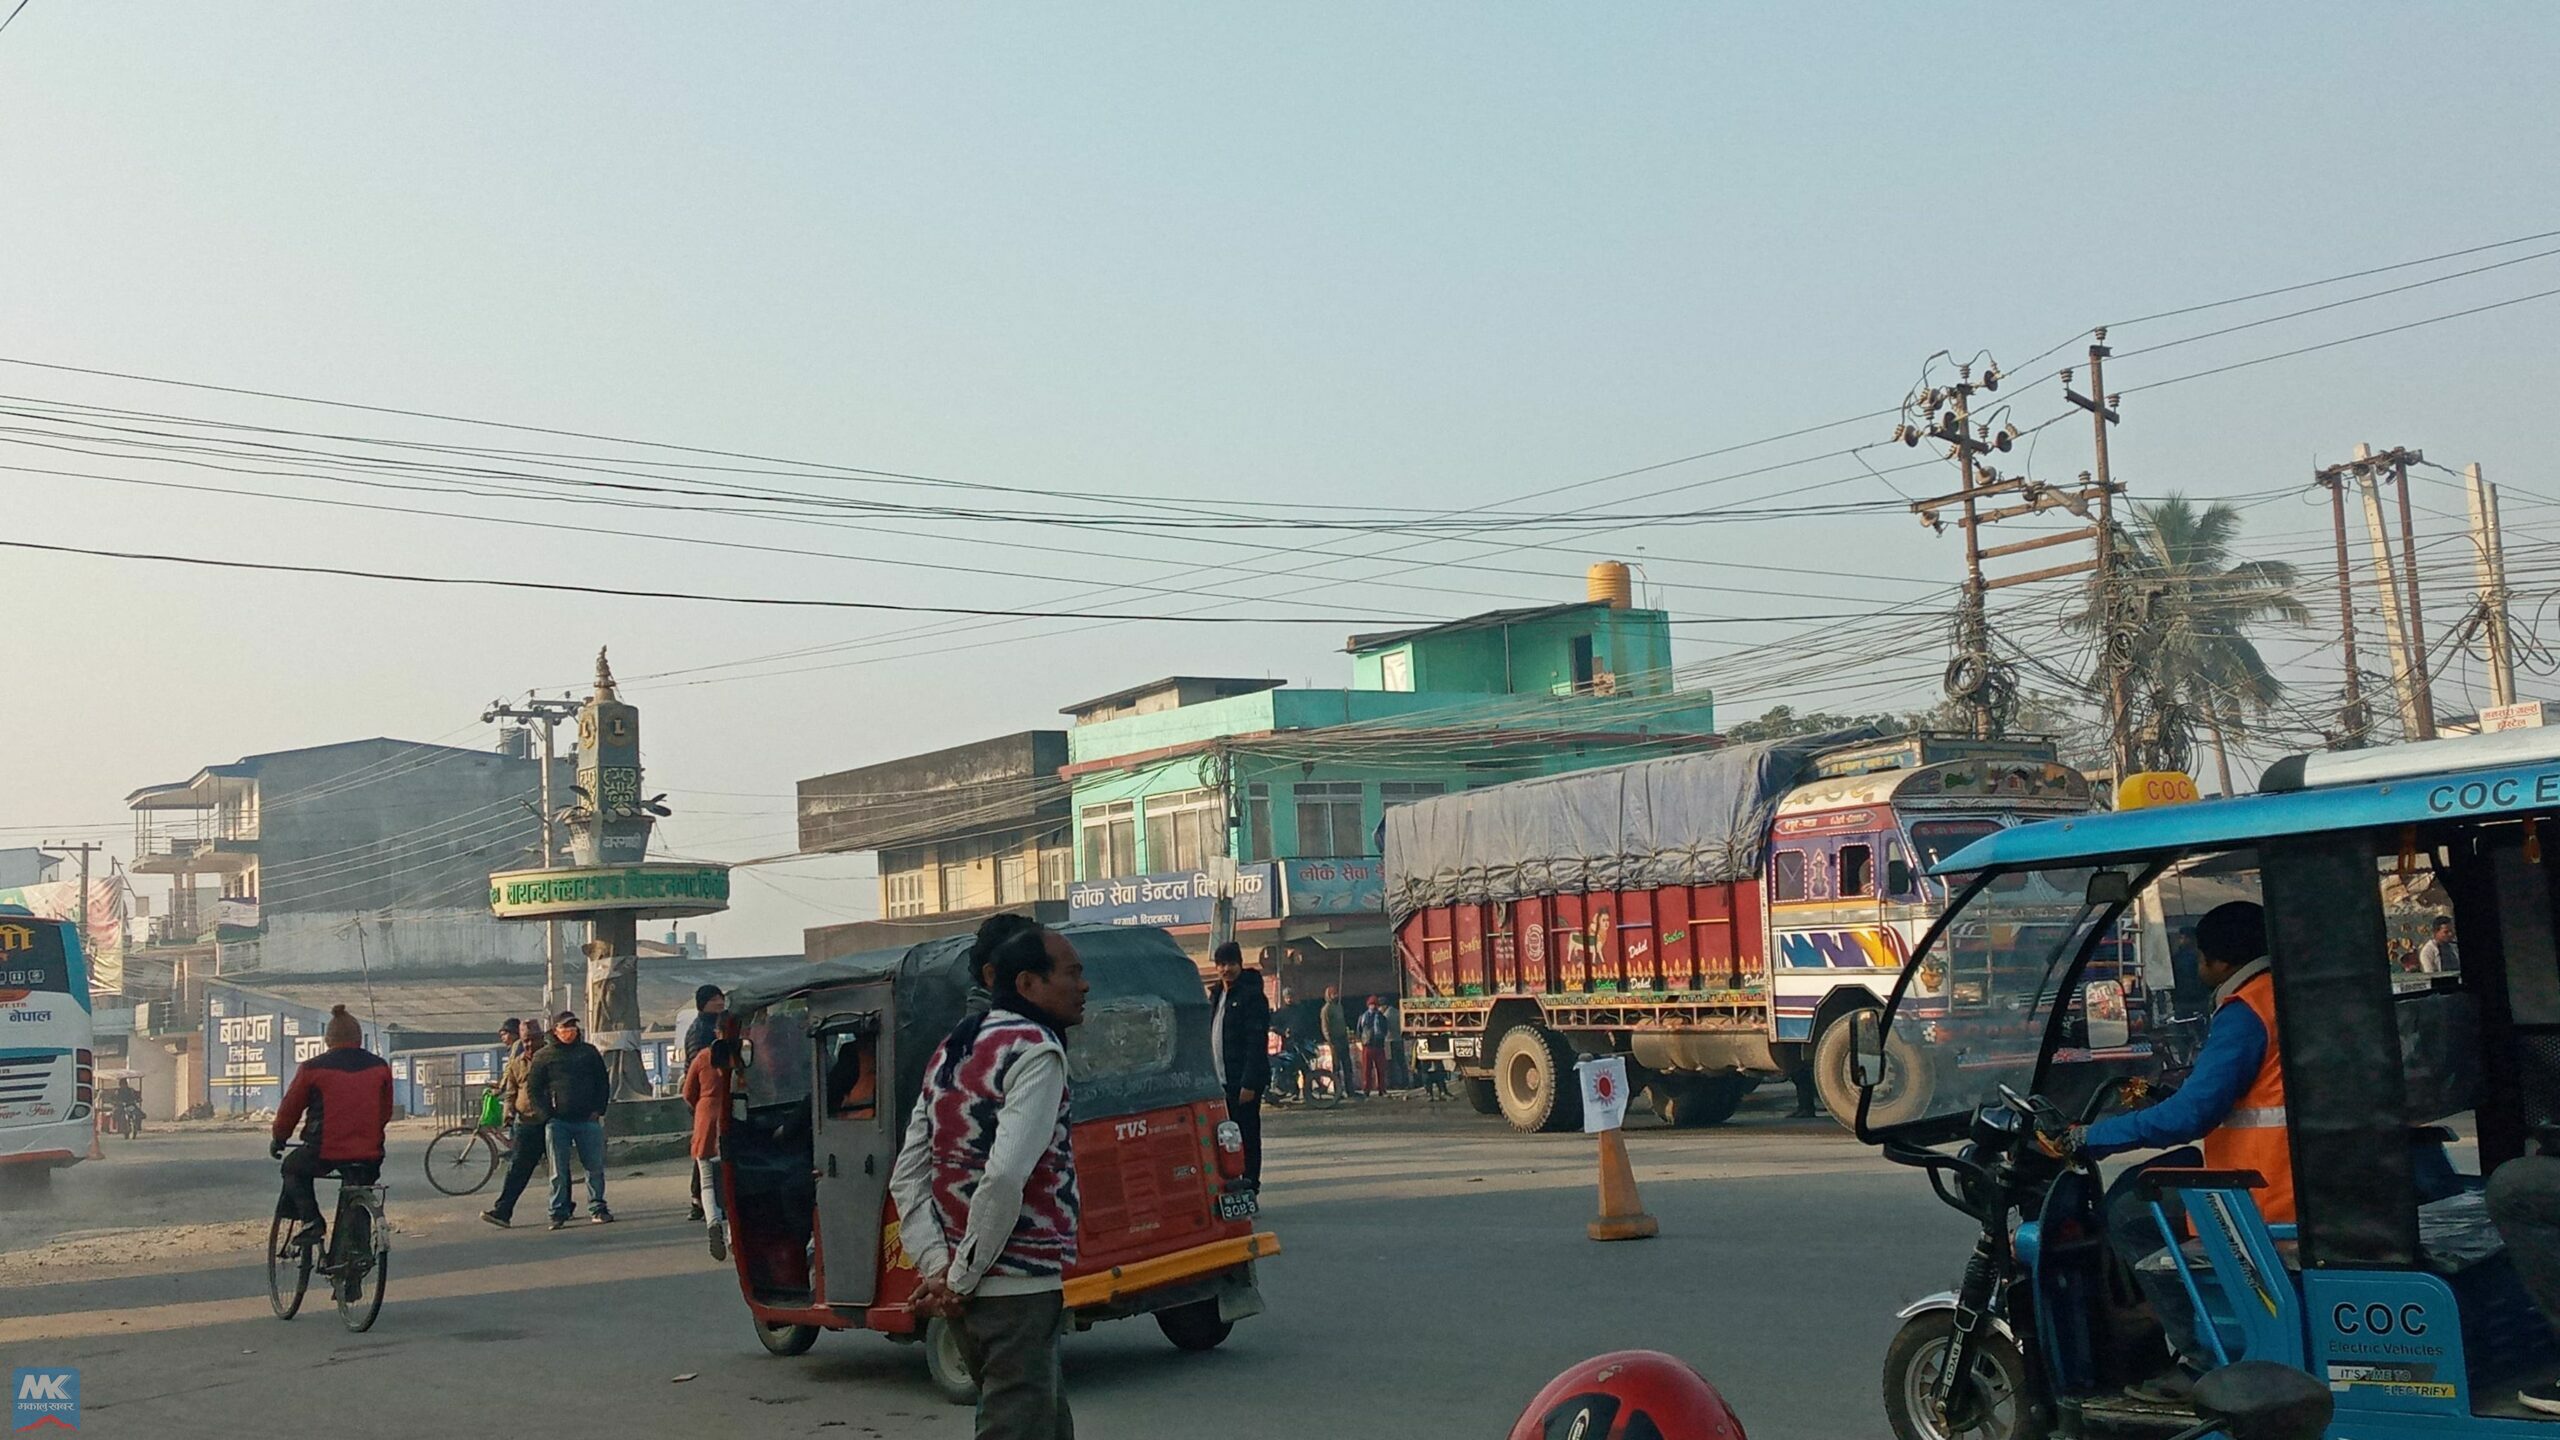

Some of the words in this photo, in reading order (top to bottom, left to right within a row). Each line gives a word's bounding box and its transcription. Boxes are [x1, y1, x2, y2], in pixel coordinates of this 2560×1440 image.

[2147, 780, 2190, 801] COC
[2428, 778, 2519, 813] COC
[1071, 884, 1105, 909] लोक
[1109, 881, 1138, 906] सेवा
[1141, 878, 1189, 902] डेन्टल
[9, 1010, 52, 1022] नेपाल
[1115, 1119, 1147, 1141] TVS
[2332, 1301, 2428, 1337] COC
[2328, 1340, 2379, 1355] Electric
[2383, 1343, 2444, 1357] Vehicles
[2340, 1369, 2361, 1380] IT'S
[2363, 1369, 2393, 1381] TIME
[2384, 1385, 2449, 1397] ELECTRIFY
